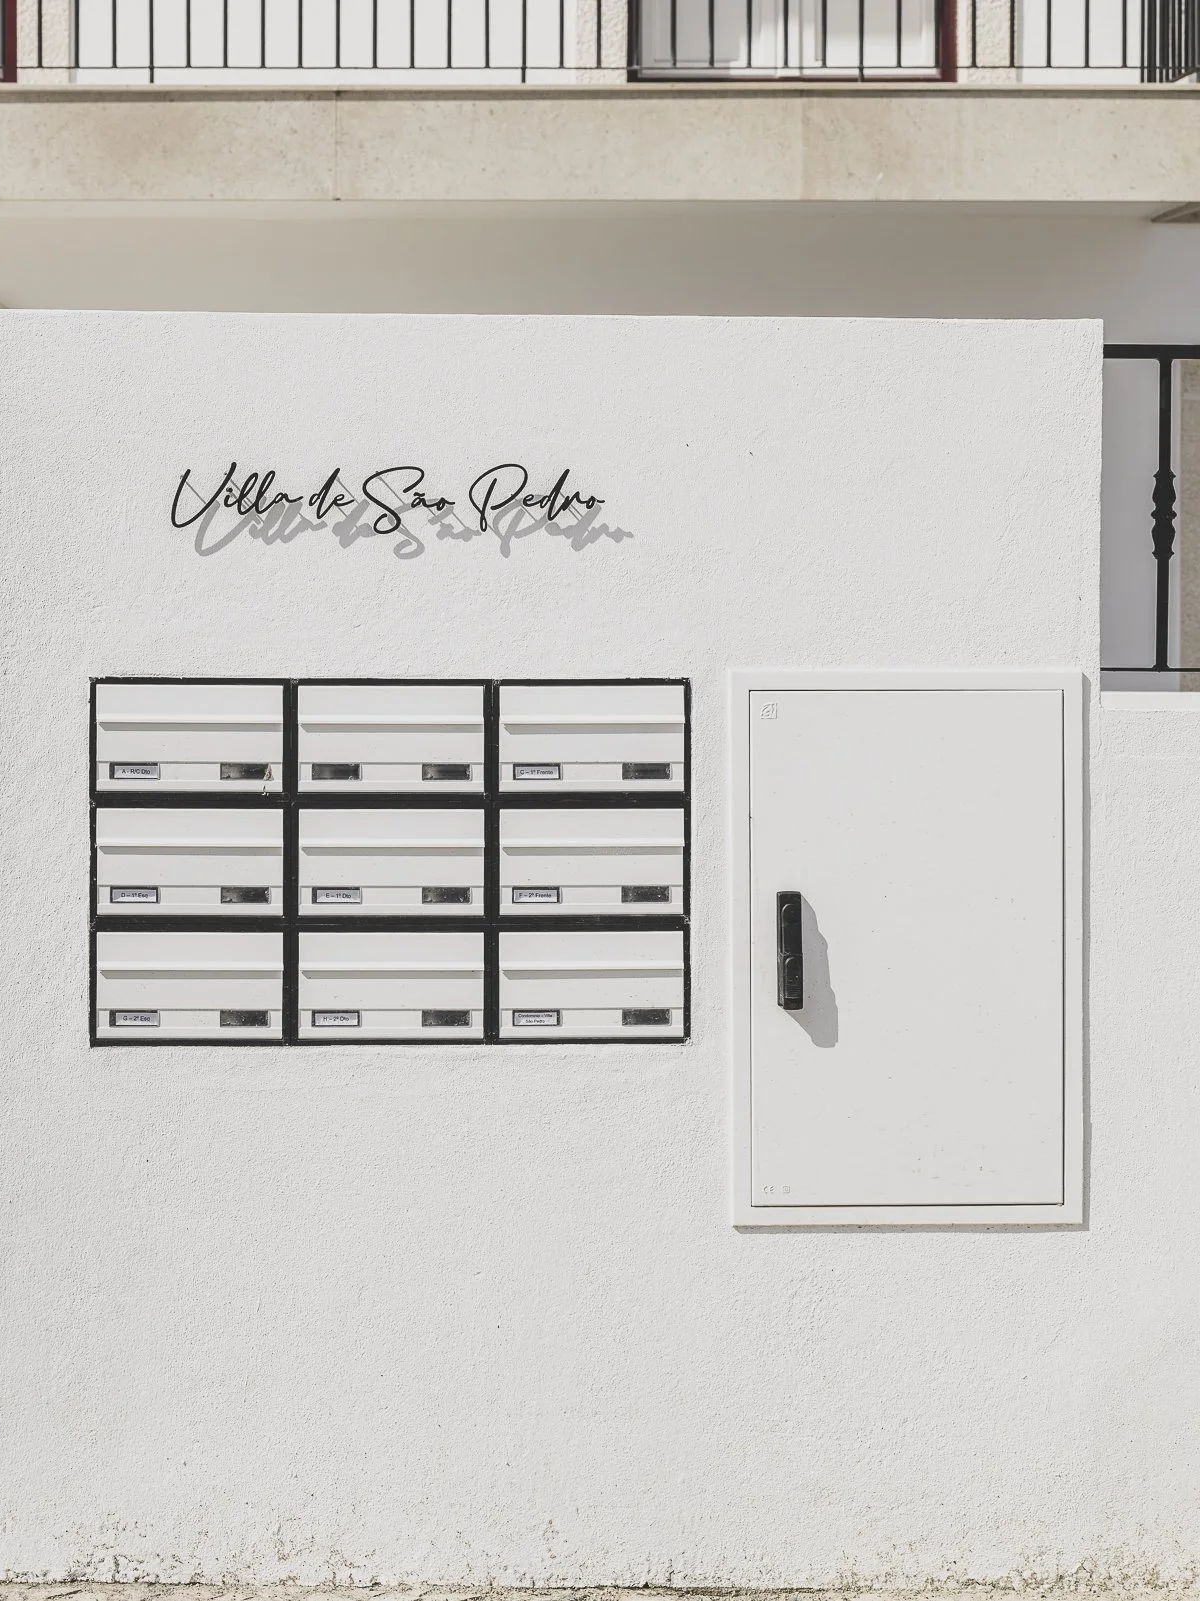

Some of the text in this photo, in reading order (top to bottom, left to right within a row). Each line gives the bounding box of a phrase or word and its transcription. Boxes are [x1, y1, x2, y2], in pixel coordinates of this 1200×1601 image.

[171, 462, 606, 535] Villa de São Pedro
